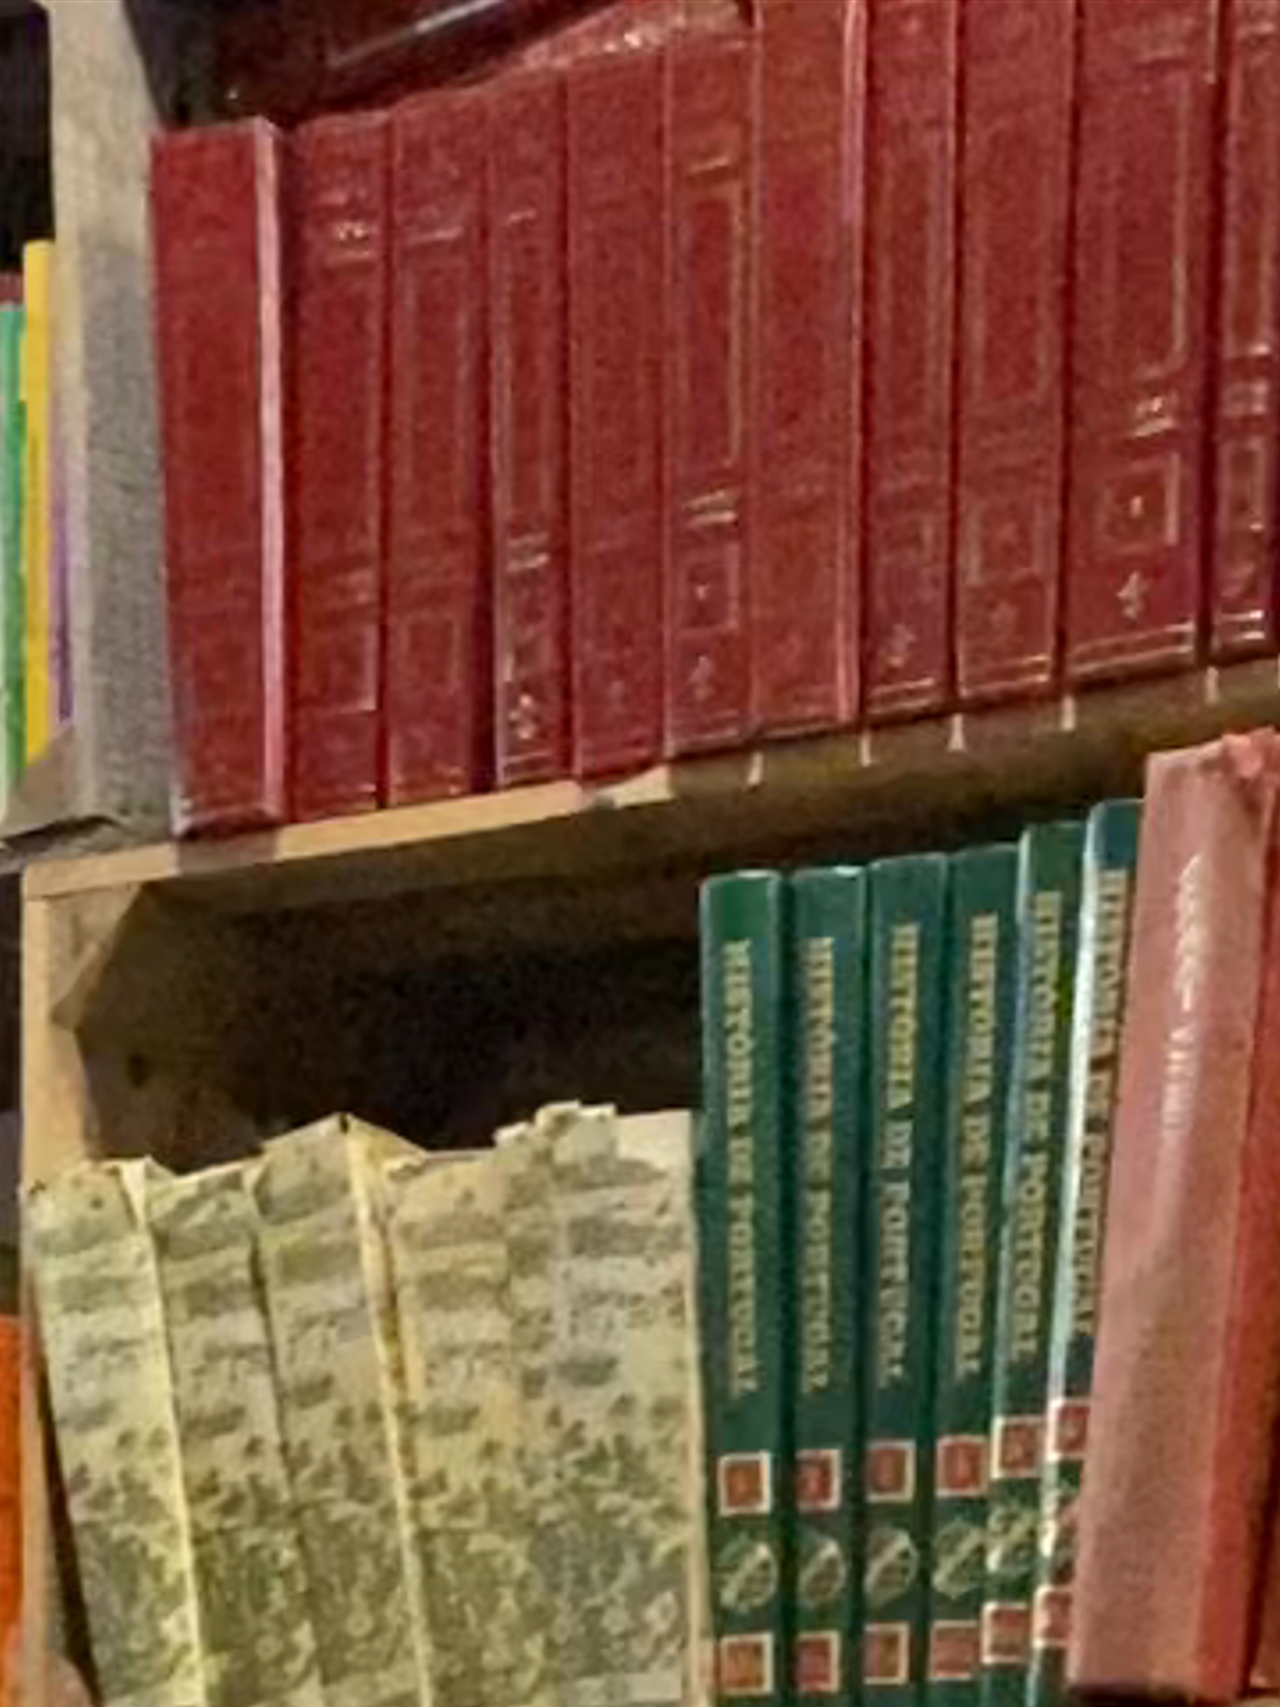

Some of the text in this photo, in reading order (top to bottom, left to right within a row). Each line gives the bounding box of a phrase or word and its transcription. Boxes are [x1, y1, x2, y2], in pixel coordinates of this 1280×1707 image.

[727, 1138, 754, 1185] DE
[804, 1130, 832, 1183] DE
[880, 1119, 913, 1170] DE
[960, 1114, 991, 1166] DE
[1023, 1091, 1053, 1146] DE
[727, 1194, 757, 1397] PORTUGAL
[802, 1187, 832, 1393] PORTUGAL
[876, 1180, 911, 1389] PORTUGAL
[952, 1174, 989, 1382] PORTUGAL
[1008, 1151, 1051, 1362] PORTUGAL
